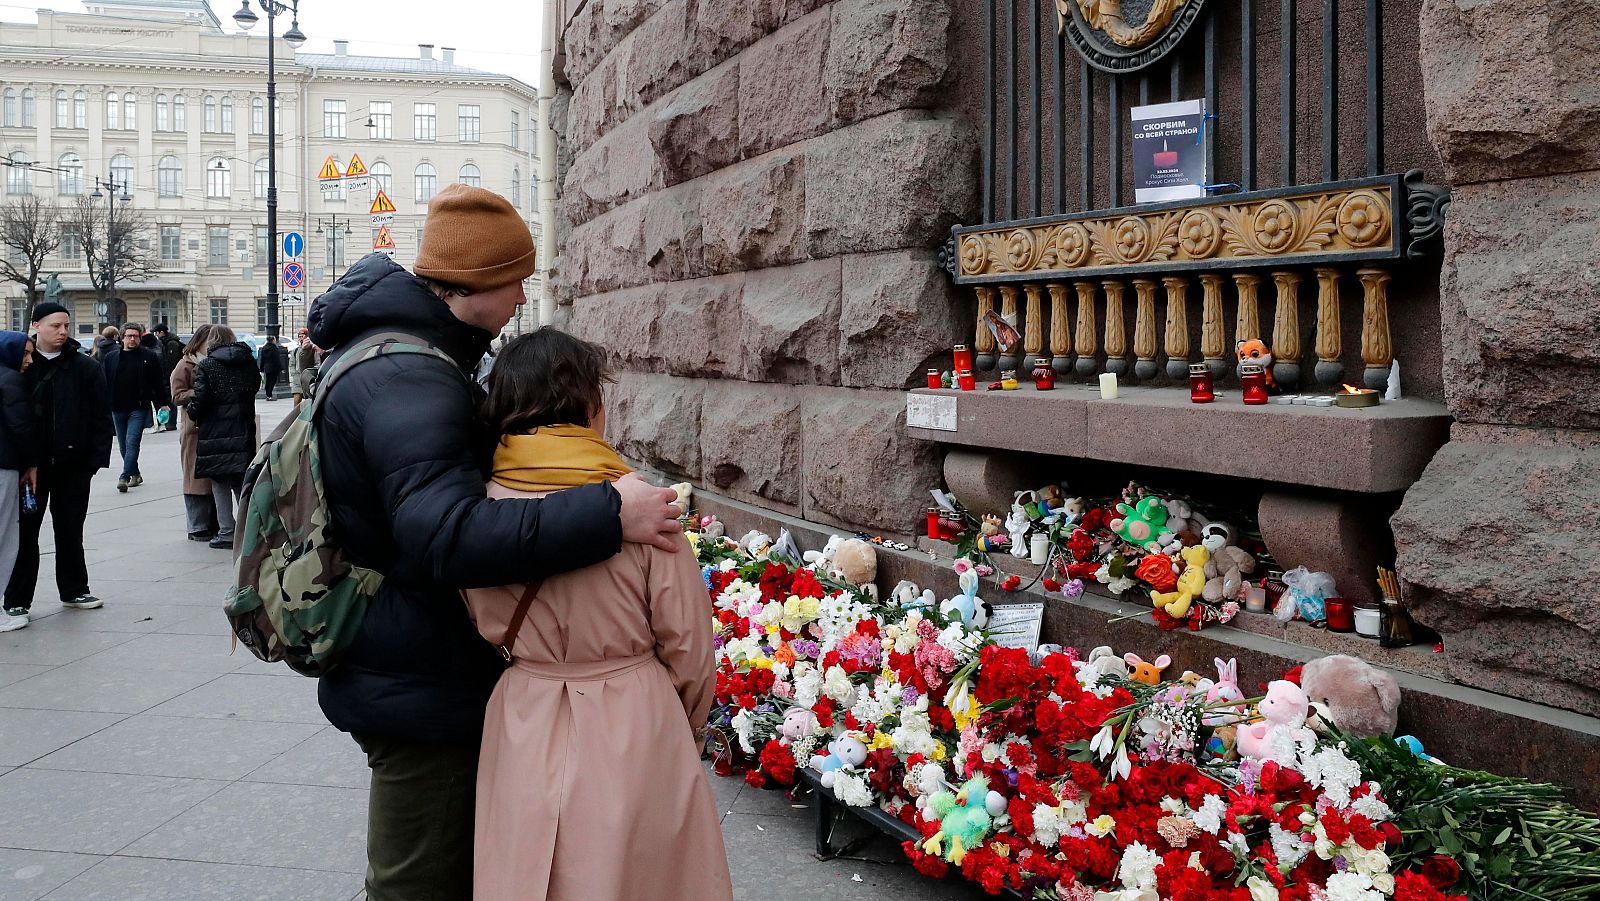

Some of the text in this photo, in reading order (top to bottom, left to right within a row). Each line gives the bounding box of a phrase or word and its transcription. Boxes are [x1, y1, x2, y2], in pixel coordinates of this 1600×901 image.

[1143, 121, 1185, 131] СКОРБИМ
[1145, 129, 1164, 138] ВСЕЙ
[1165, 126, 1197, 136] СТРАНОЙ
